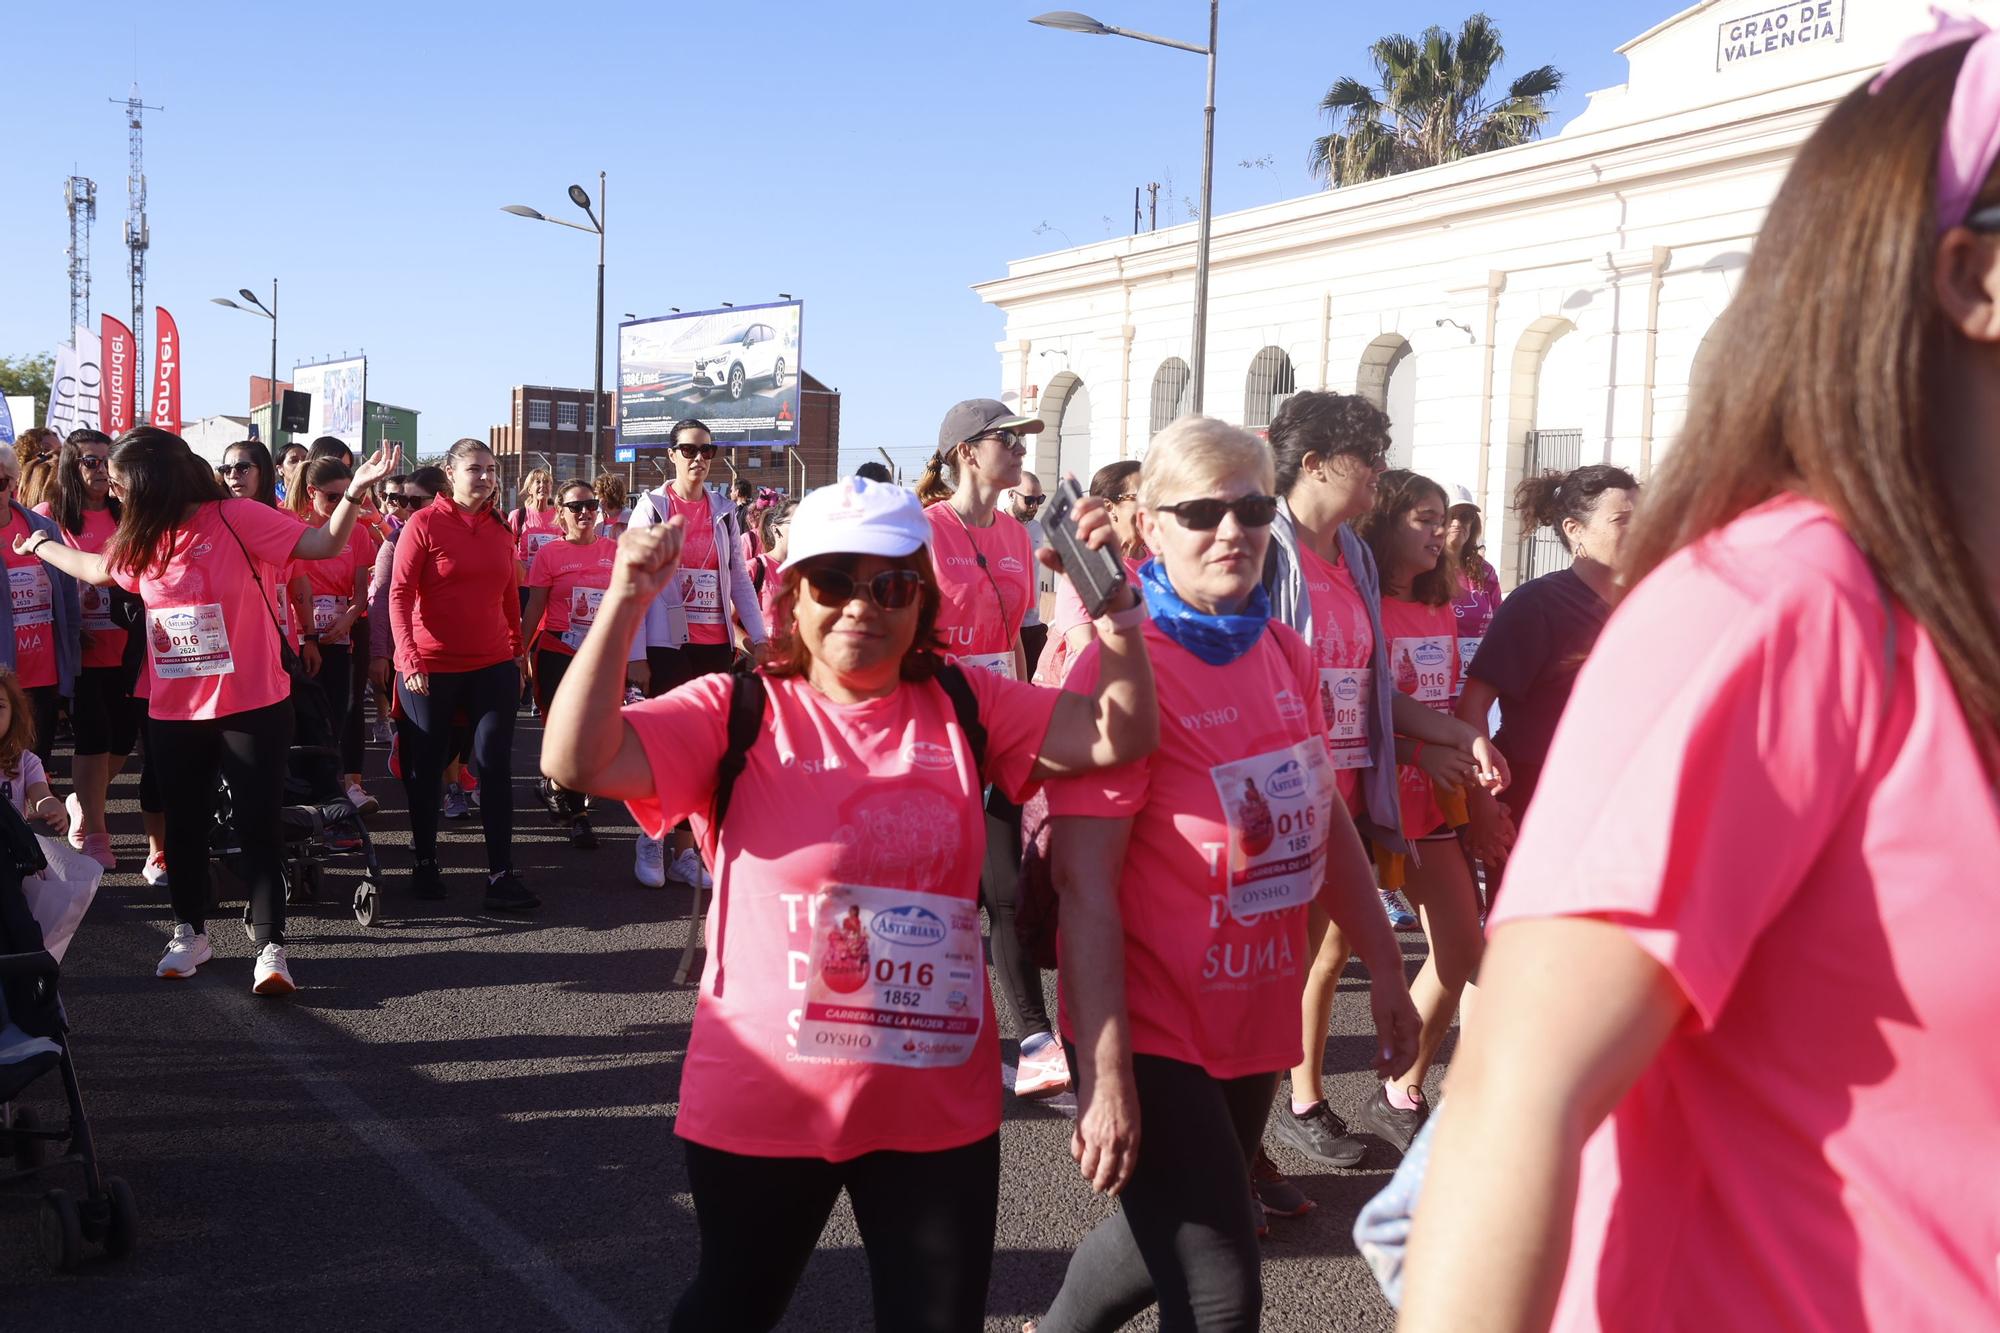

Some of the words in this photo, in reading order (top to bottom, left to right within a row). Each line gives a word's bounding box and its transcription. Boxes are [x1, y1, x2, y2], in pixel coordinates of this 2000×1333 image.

[1730, 14, 1789, 42] GRAO
[1800, 1, 1832, 24] DE
[1724, 20, 1834, 62] VALENCIA
[11, 589, 34, 600] 016
[697, 590, 715, 600] 016
[314, 613, 334, 621] 016
[172, 635, 199, 646] 016
[947, 625, 974, 646] TU
[180, 647, 197, 655] 2624
[1420, 672, 1445, 687] 016
[1180, 706, 1239, 729] OYSHO
[1337, 708, 1357, 723] 016
[1277, 805, 1316, 835] 016
[1241, 884, 1290, 904] OYSHO
[877, 917, 941, 938] ASTURIANA
[1203, 933, 1293, 979] SUMA
[875, 958, 934, 986] 016
[884, 988, 921, 1008] 1852
[825, 1008, 876, 1022] CARRERA
[877, 1014, 894, 1024] DE
[895, 1016, 909, 1026] LA
[910, 1017, 945, 1029] MUJER
[816, 1031, 872, 1048] OYSHO
[917, 1042, 964, 1055] Santander
